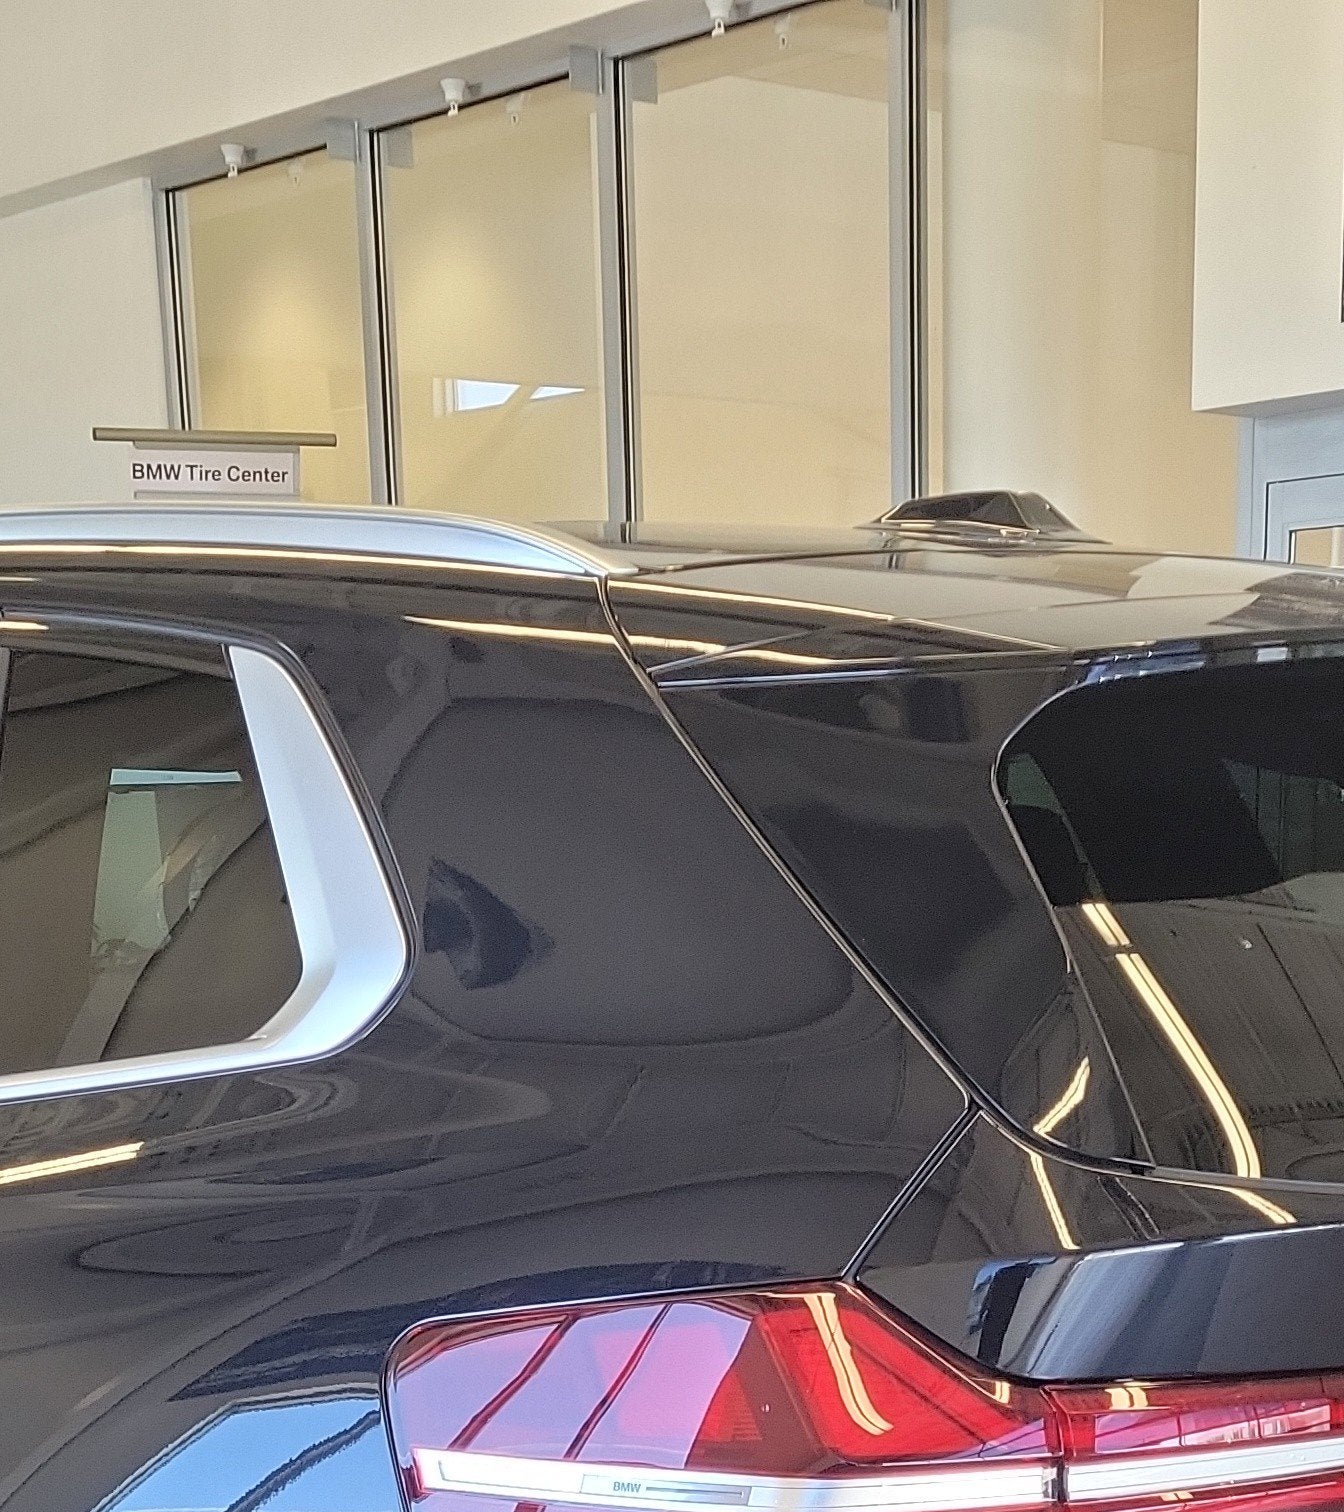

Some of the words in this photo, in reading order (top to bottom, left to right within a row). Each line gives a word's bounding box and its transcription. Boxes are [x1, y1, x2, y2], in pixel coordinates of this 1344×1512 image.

[131, 462, 181, 481] BMW
[185, 464, 222, 482] Tire
[227, 465, 289, 483] Center
[613, 1481, 642, 1493] BMW
